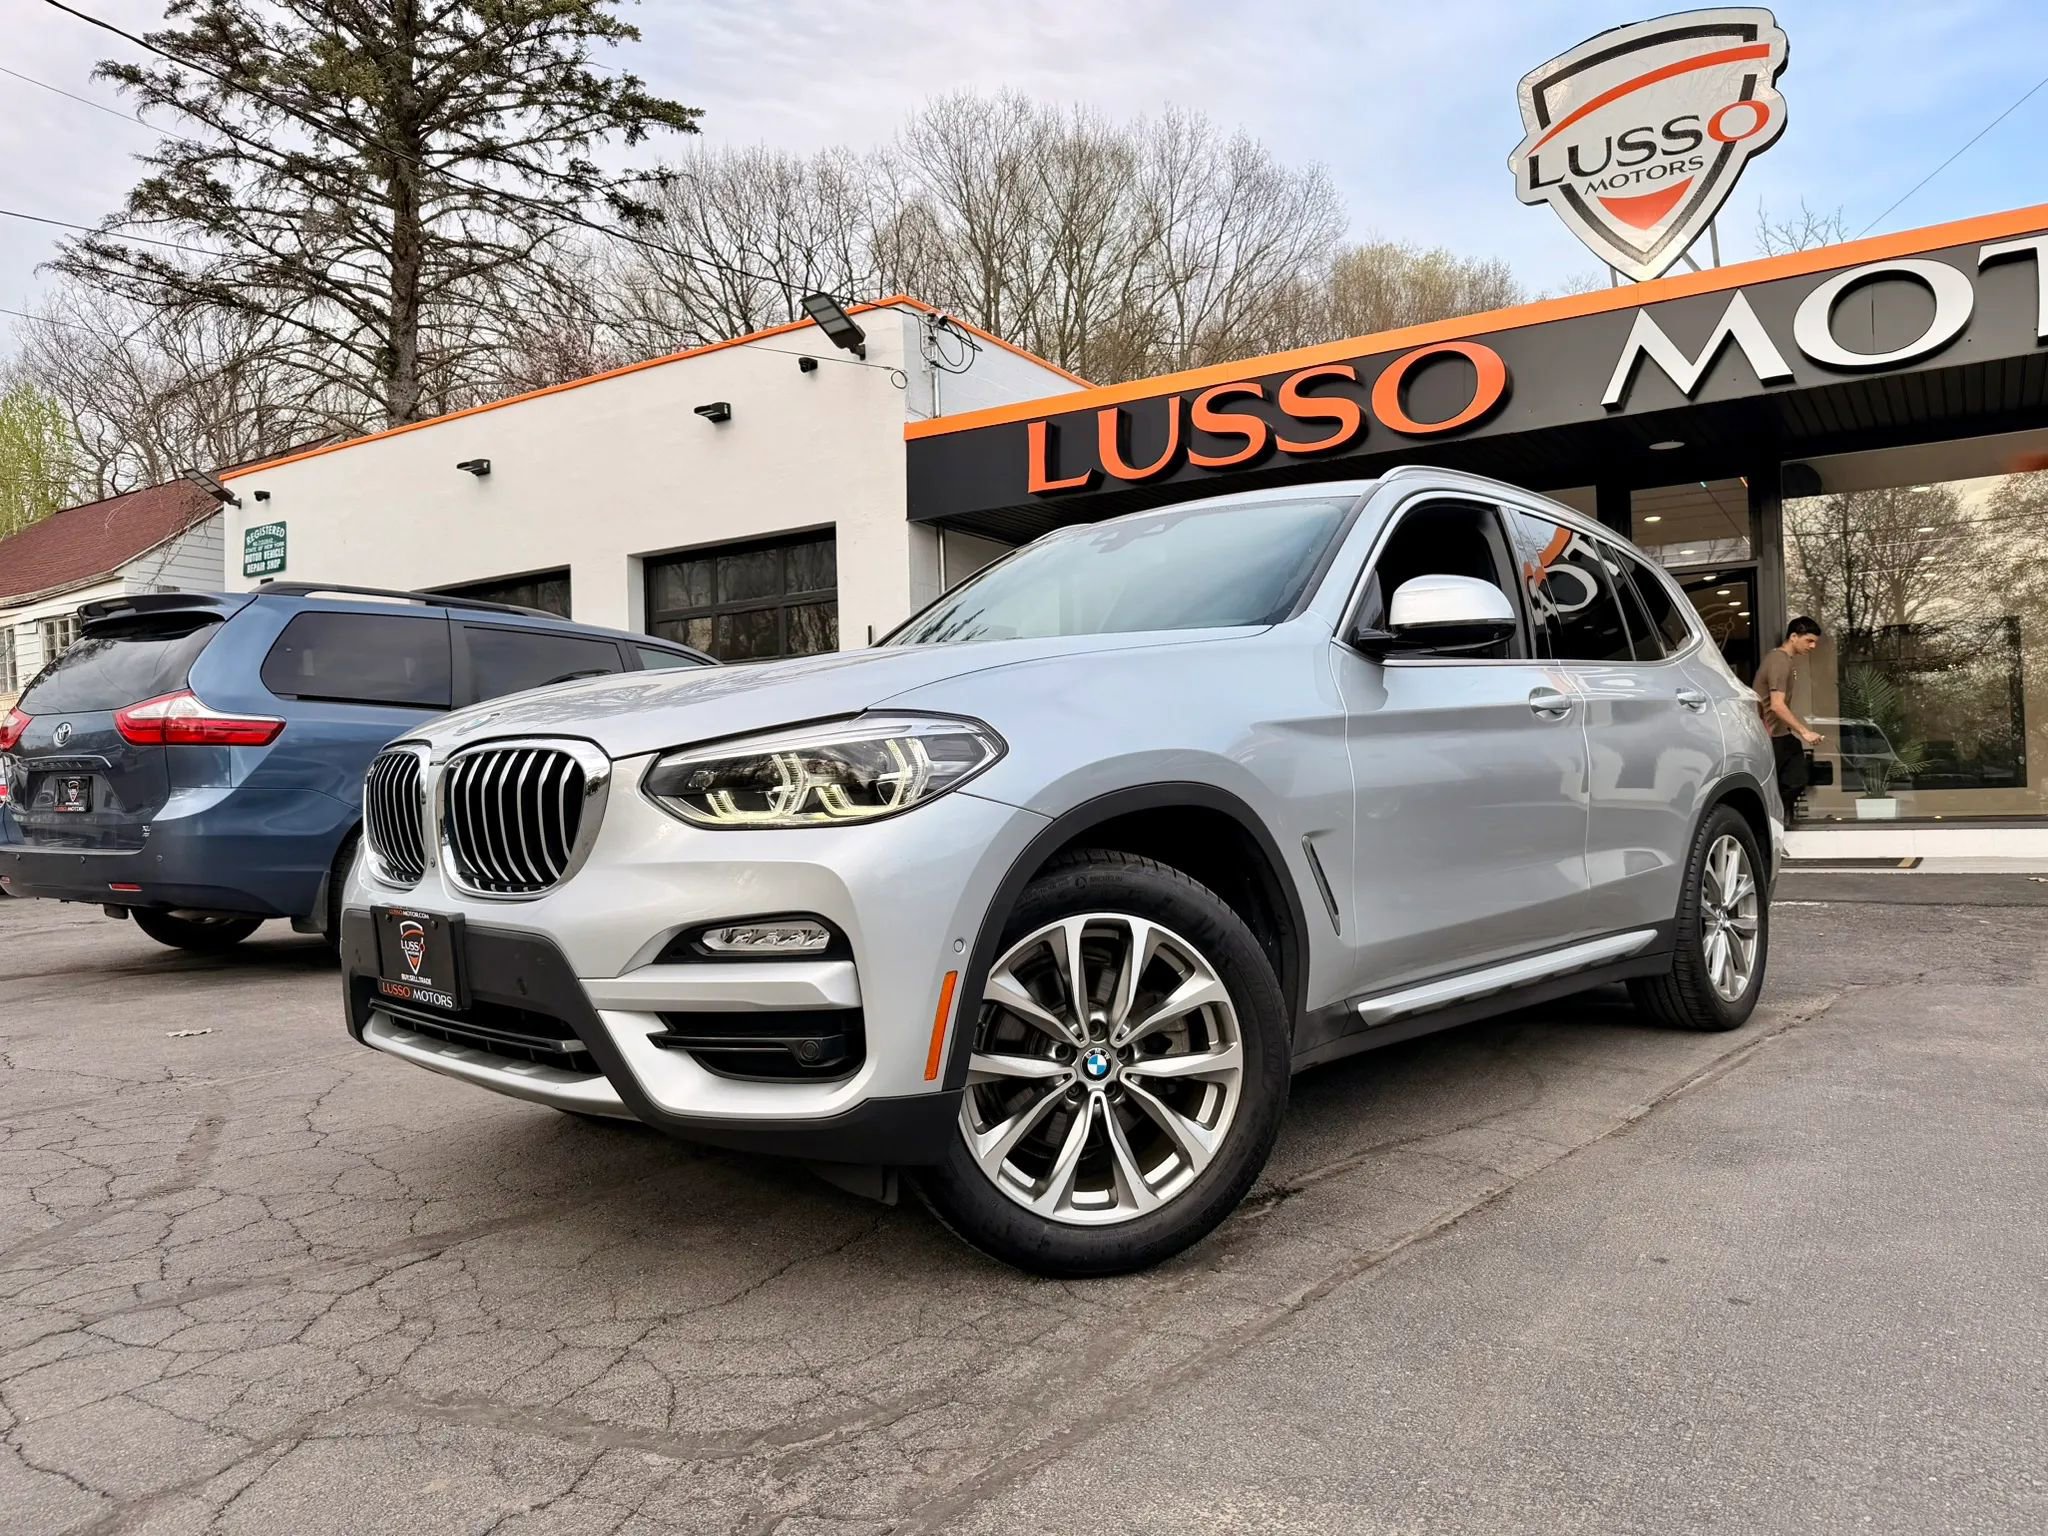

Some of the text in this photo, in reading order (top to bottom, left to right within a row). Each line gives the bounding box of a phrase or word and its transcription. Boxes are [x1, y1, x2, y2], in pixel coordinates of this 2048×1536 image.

[1528, 100, 1770, 190] LUSSO
[1584, 156, 1703, 195] MOTORS
[1027, 341, 1508, 496] LUSSO
[246, 526, 285, 546] REGISTERED
[245, 546, 285, 564] MOTOR VEHICLE
[247, 558, 281, 574] REPAIR SHOP
[400, 939, 425, 952] LUSSO
[382, 982, 453, 1008] LUSSO MOTORS
